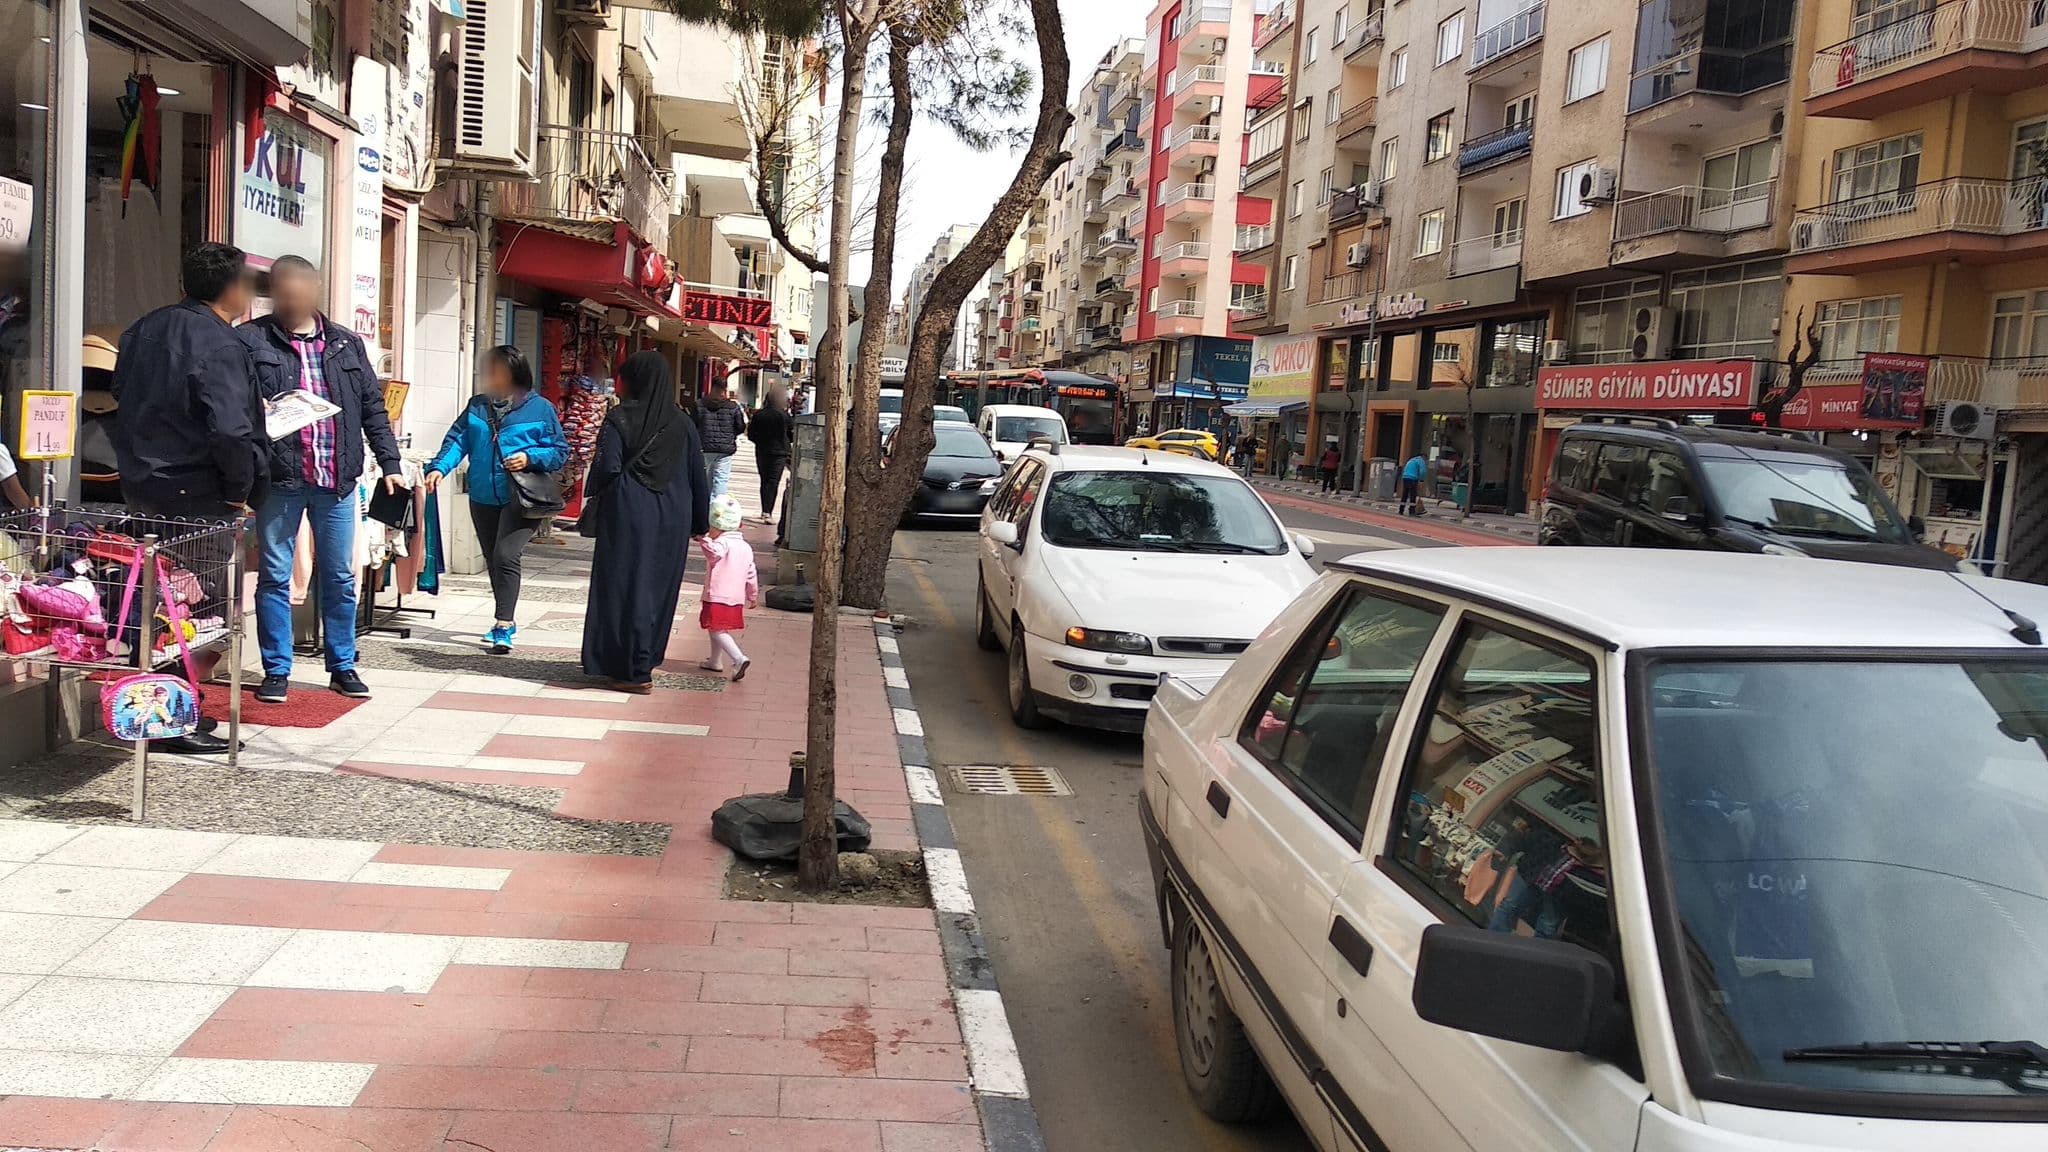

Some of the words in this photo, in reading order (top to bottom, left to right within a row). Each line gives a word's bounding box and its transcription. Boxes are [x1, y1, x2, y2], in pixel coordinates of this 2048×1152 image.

[244, 129, 306, 195] KUL
[1214, 352, 1241, 362] TEKEL
[1542, 373, 1593, 399] SÜMER
[1598, 371, 1647, 399] GİYİM
[1652, 368, 1743, 398] DÜNYASI
[1821, 399, 1859, 413] MİNYAT
